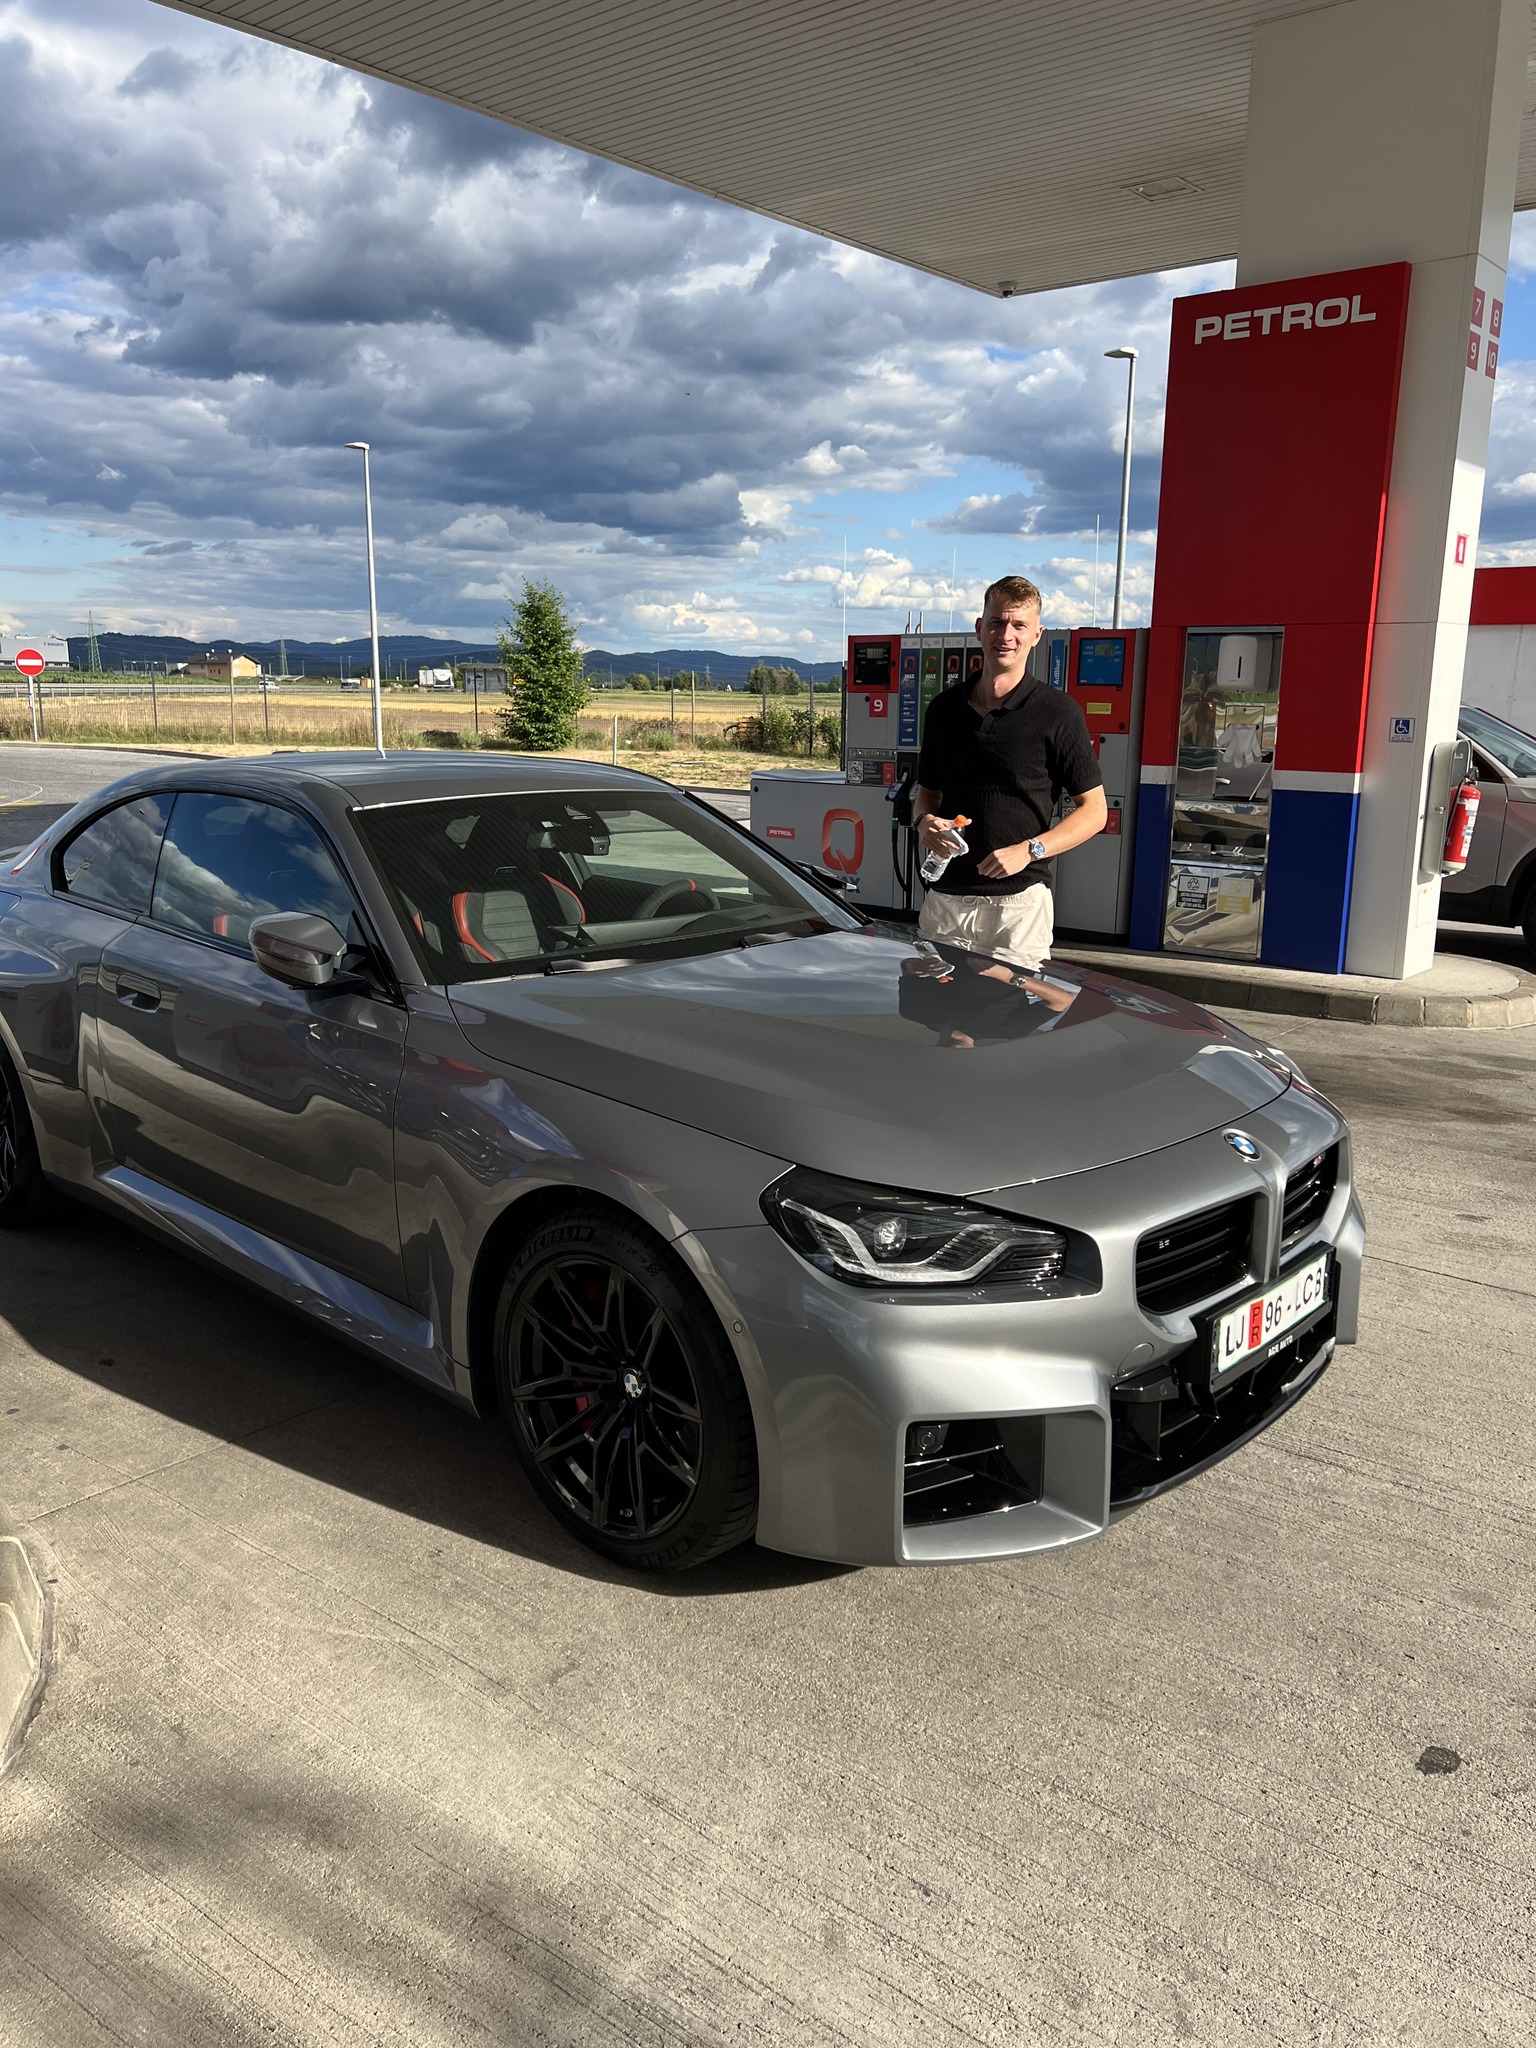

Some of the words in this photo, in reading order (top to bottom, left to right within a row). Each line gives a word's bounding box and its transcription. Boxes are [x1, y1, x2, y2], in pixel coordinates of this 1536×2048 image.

[1475, 298, 1482, 316] 7
[1194, 294, 1377, 345] PETROL
[1493, 309, 1500, 328] 8
[1470, 342, 1477, 360] 9
[1487, 350, 1496, 369] 10
[873, 699, 883, 712] 9
[822, 808, 865, 875] Q
[521, 1226, 592, 1265] MICHELIN
[1225, 1315, 1245, 1356] LJ
